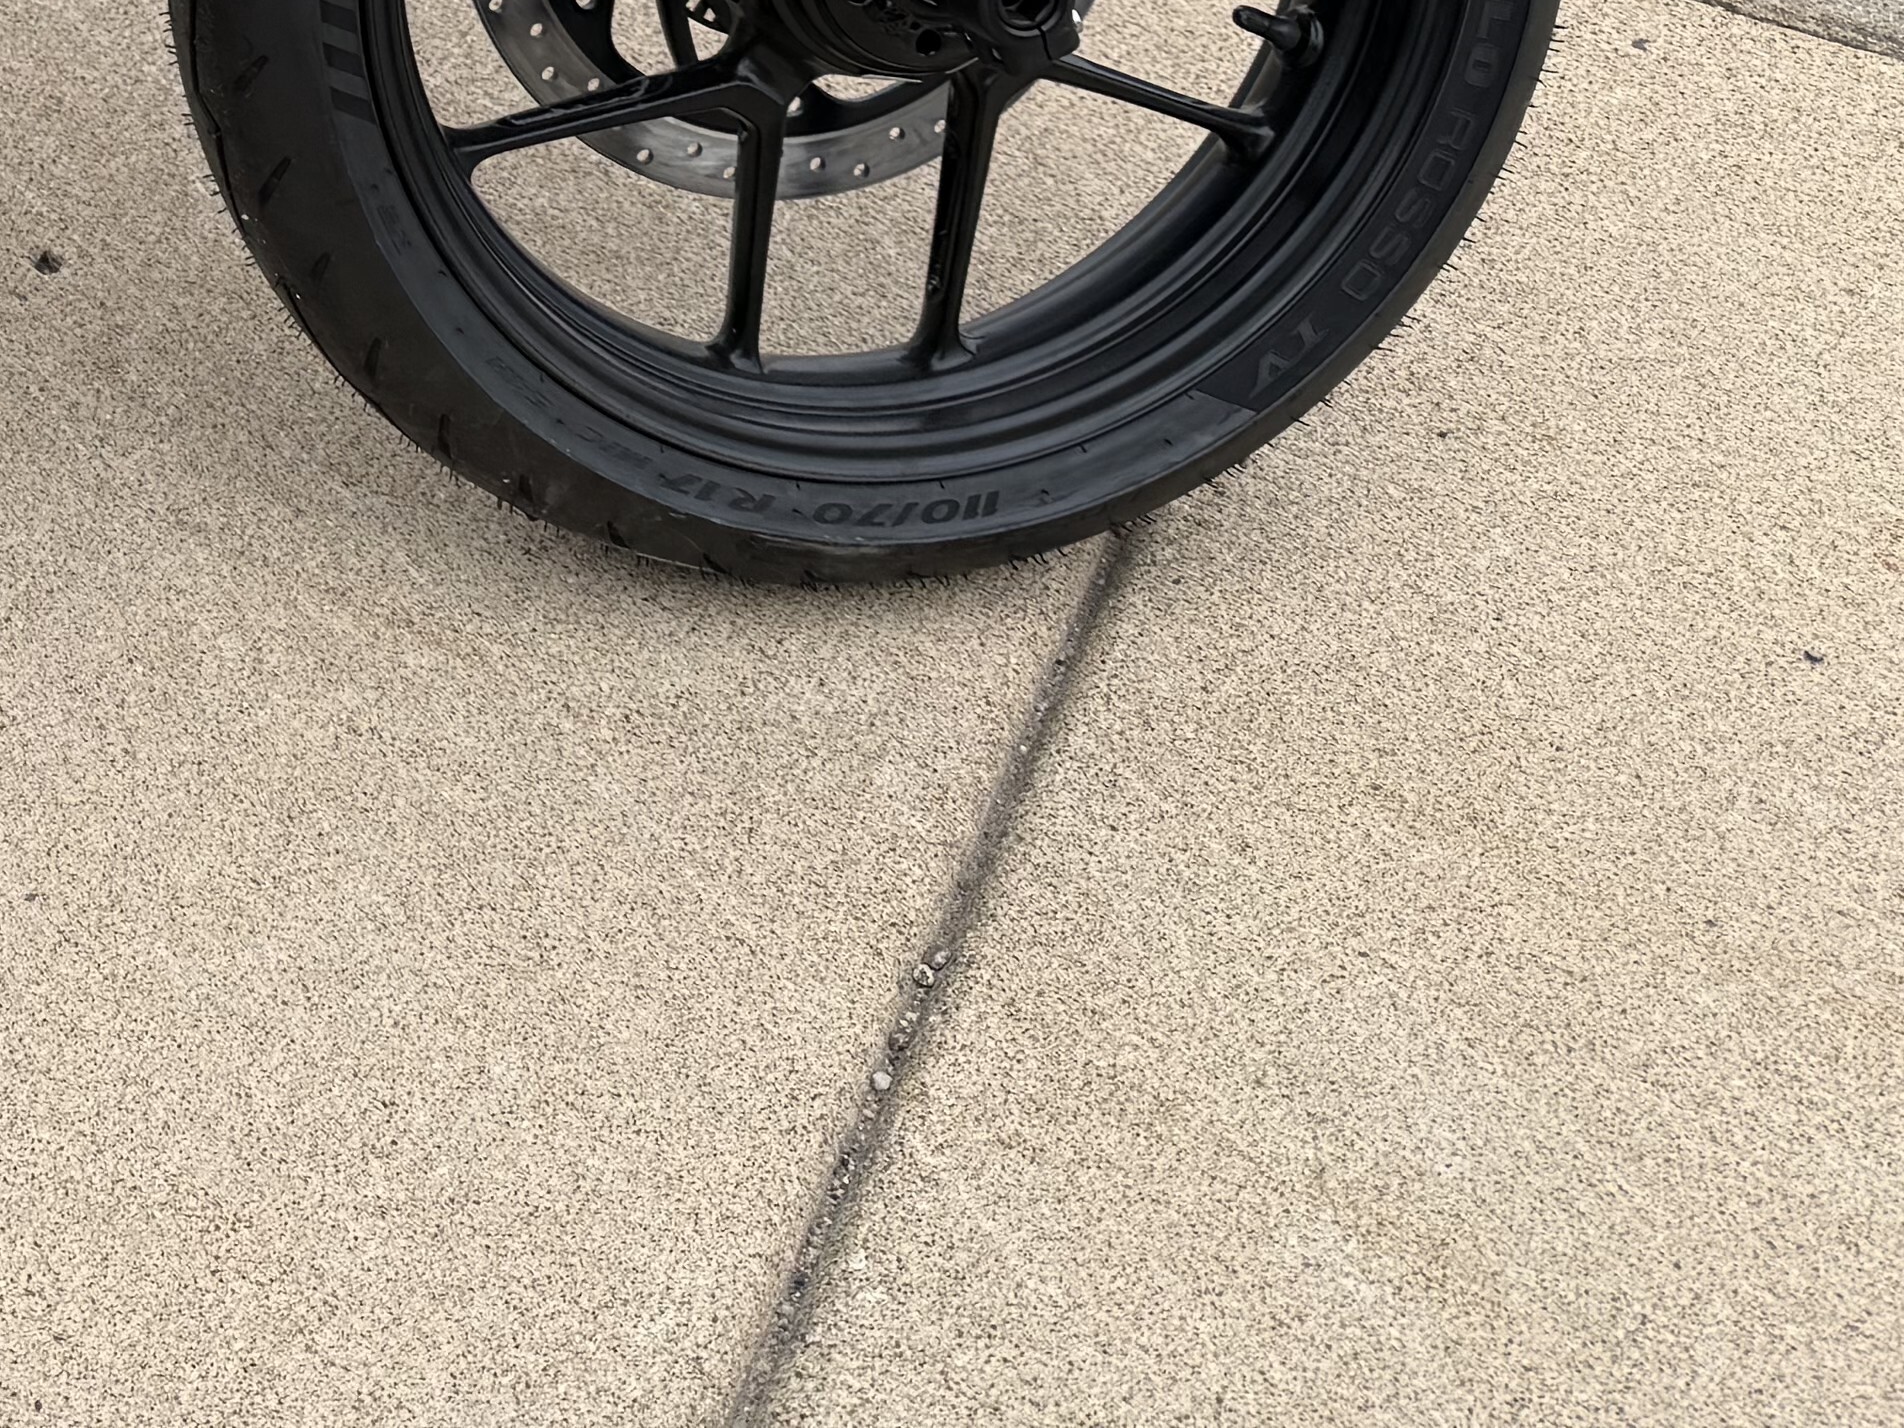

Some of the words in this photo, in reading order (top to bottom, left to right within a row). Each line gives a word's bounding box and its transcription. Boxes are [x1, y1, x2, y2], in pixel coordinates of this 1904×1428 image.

[1335, 102, 1479, 307] ROSSO
[1248, 309, 1326, 401] IV
[810, 488, 1001, 527] 110/70
